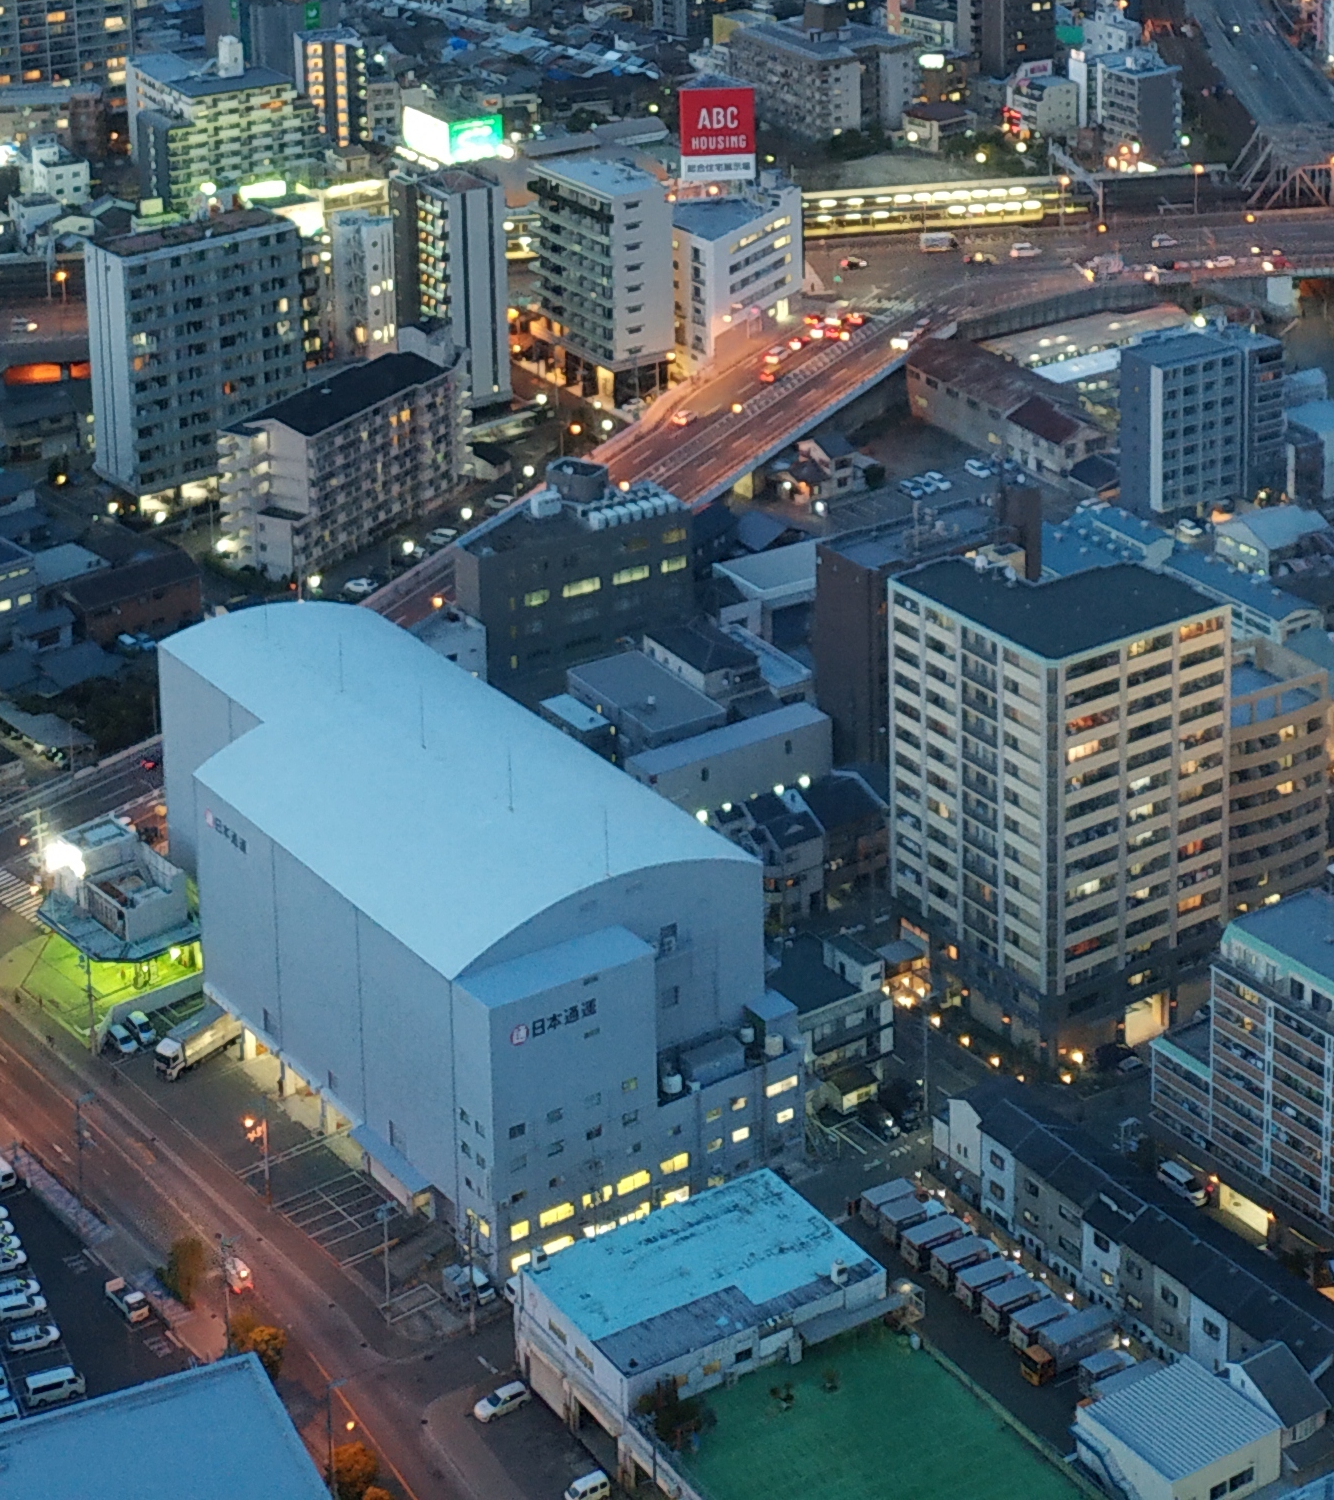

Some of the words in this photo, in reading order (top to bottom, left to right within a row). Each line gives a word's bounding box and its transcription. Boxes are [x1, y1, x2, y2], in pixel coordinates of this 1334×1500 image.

[697, 106, 739, 130] ABC
[691, 134, 747, 150] HOUSING
[532, 997, 597, 1038] 日本通運
